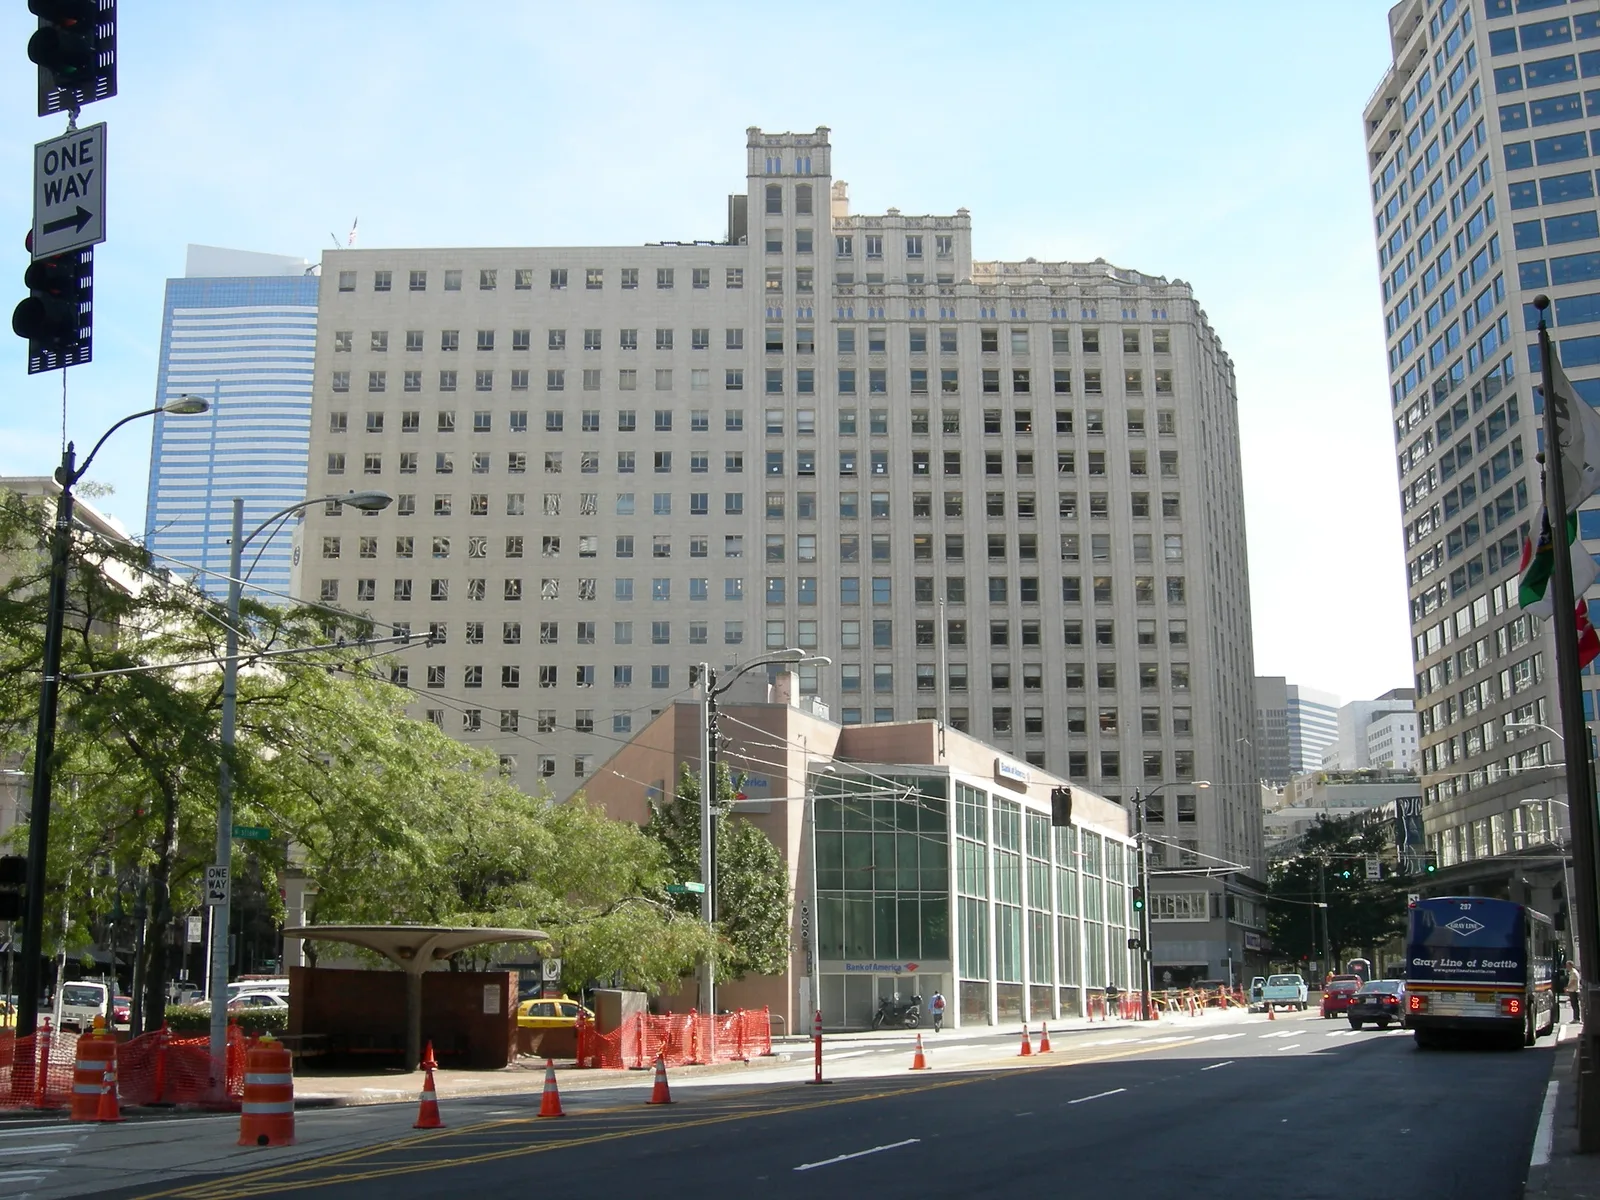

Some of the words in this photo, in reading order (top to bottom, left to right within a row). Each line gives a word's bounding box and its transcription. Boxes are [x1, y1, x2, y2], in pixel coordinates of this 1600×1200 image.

[43, 137, 94, 176] ONE
[43, 168, 95, 207] WAY
[208, 868, 227, 878] ONE
[208, 880, 227, 889] WAY
[846, 963, 865, 971] Bank
[865, 963, 872, 971] of
[873, 963, 902, 971] America
[1412, 957, 1438, 968] Gray
[1440, 958, 1463, 967] Line
[1466, 959, 1477, 967] of
[1481, 959, 1518, 969] Seattle
